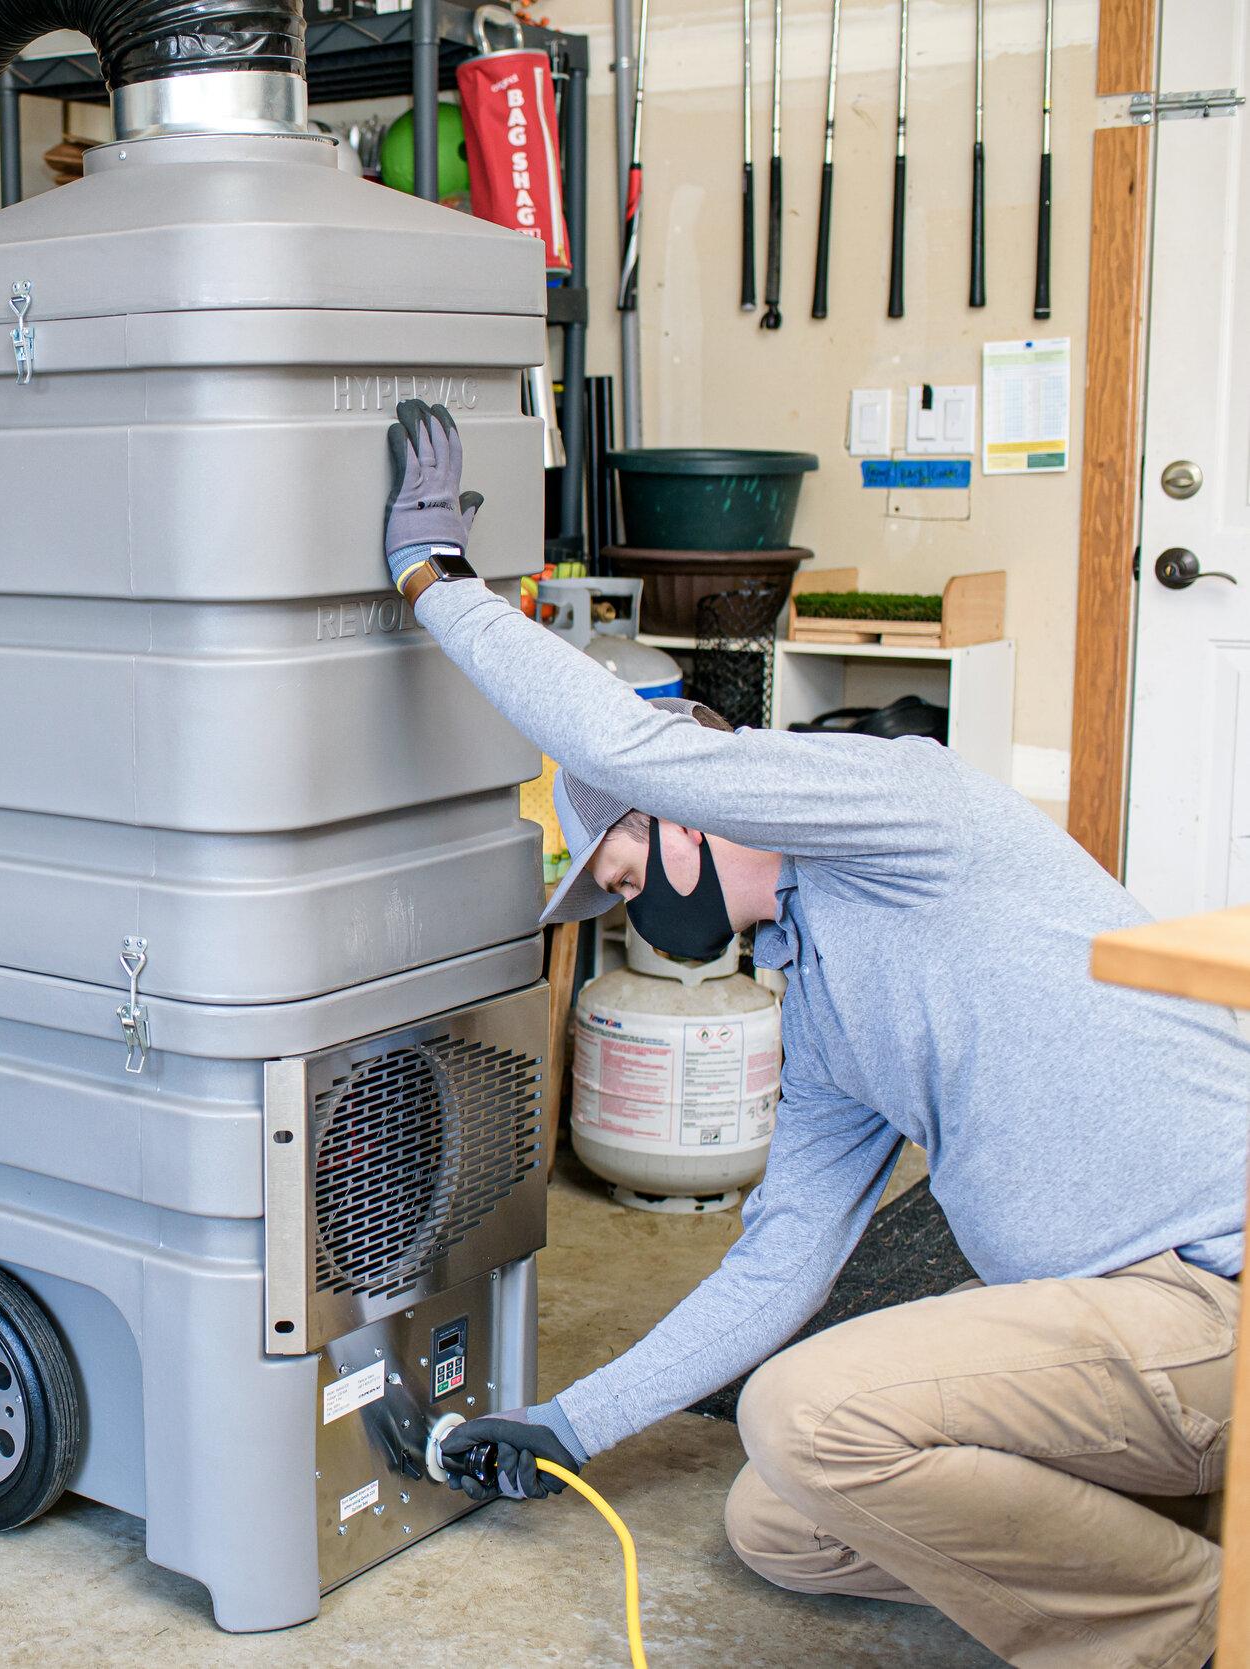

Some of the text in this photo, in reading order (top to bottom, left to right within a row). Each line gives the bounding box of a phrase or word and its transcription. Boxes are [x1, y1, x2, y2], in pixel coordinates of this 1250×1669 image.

[507, 88, 527, 147] BAG
[512, 152, 536, 227] SHAG
[333, 375, 479, 411] HYPERVAC
[316, 598, 425, 641] REVOL
